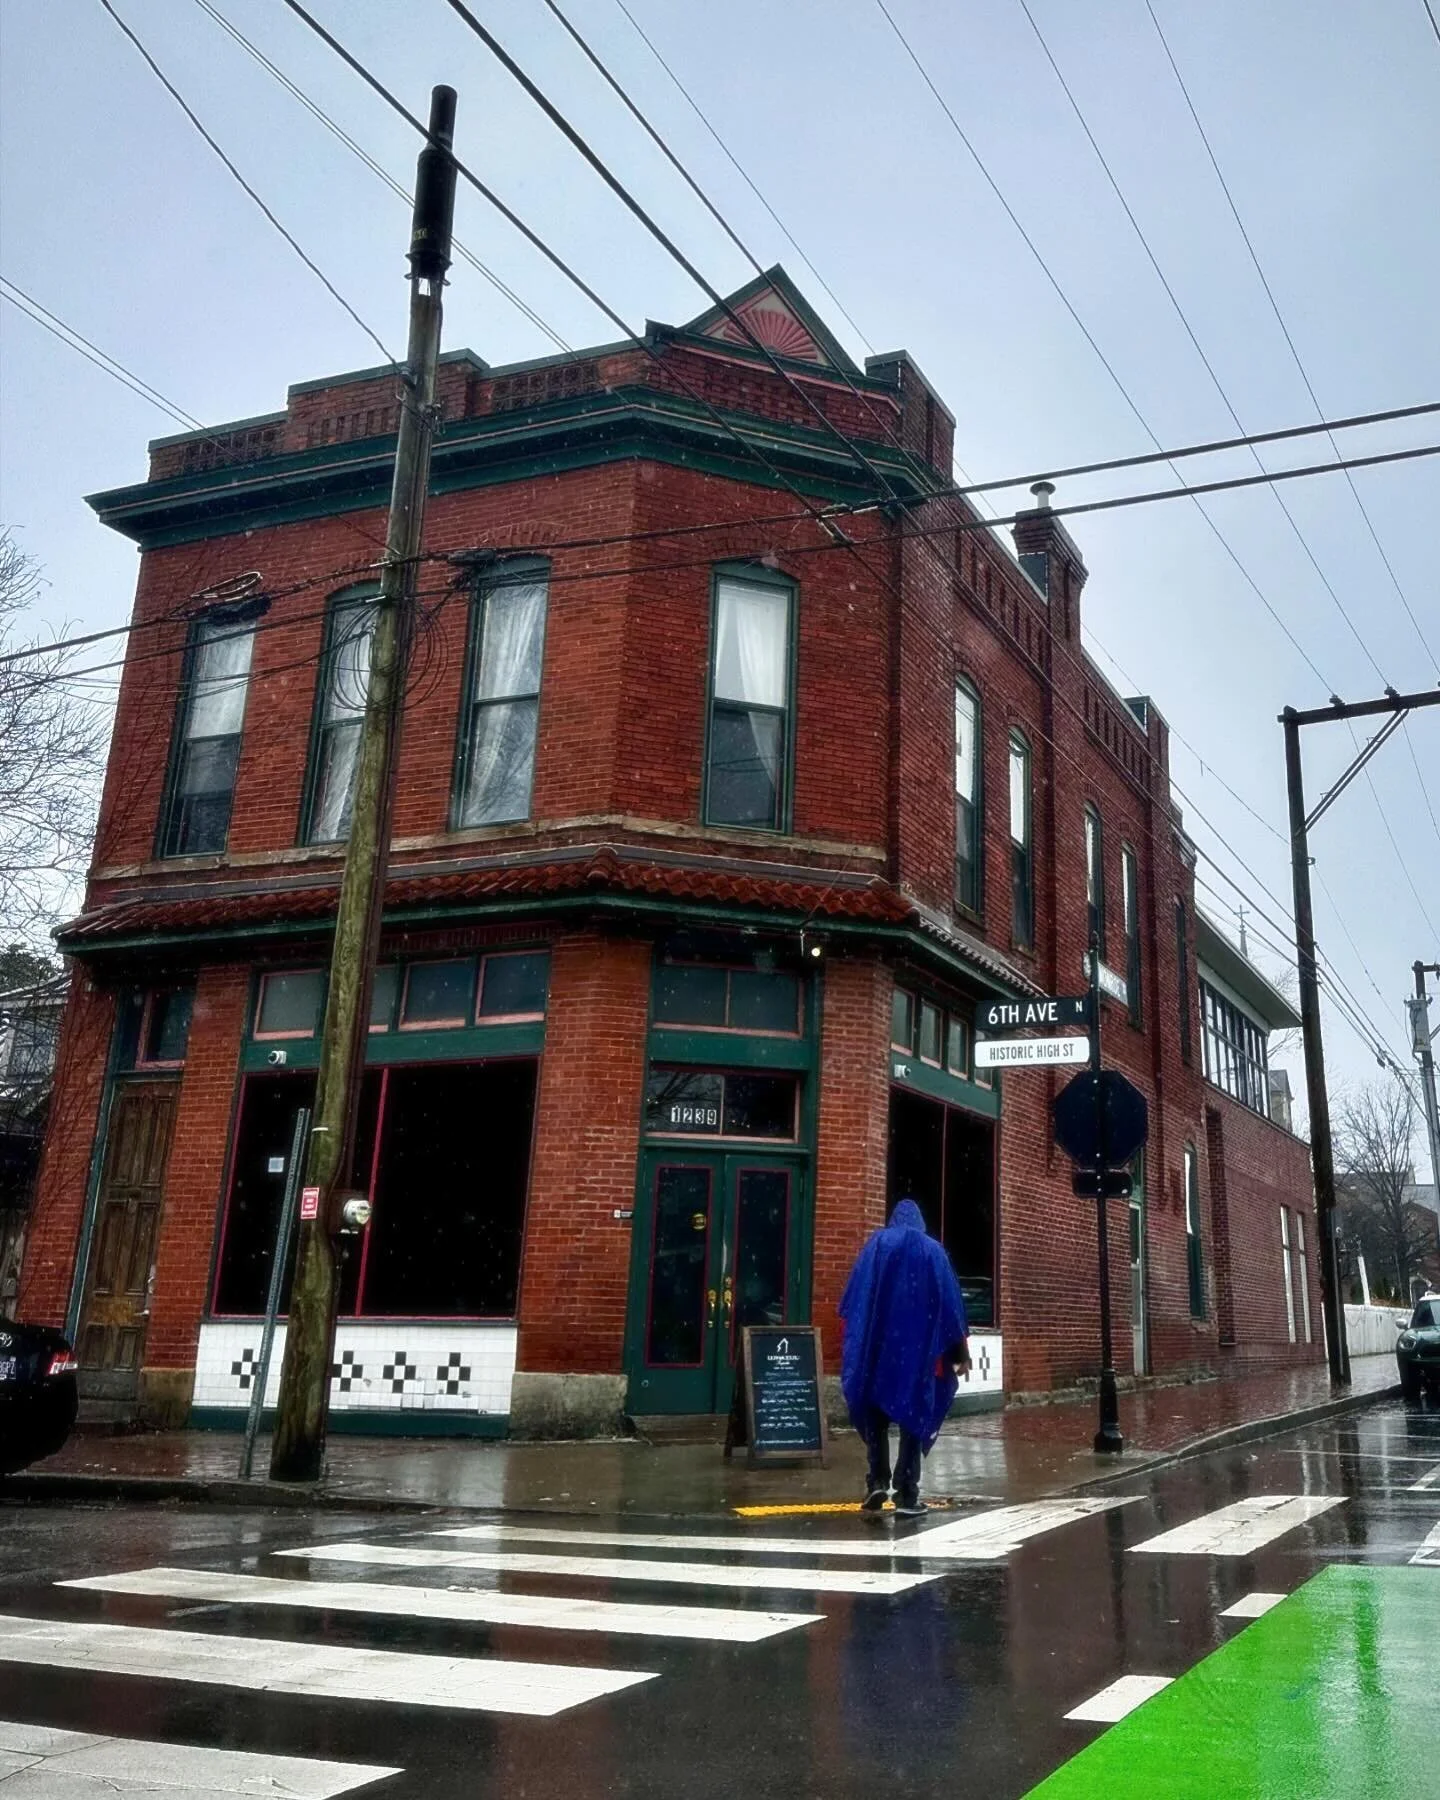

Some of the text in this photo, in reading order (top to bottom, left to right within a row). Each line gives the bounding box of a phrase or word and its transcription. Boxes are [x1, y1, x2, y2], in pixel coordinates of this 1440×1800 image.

[988, 1000, 1083, 1024] 6TH AVE N
[989, 1043, 1075, 1060] HISTORIC HIGH ST
[671, 1107, 717, 1125] 1239
